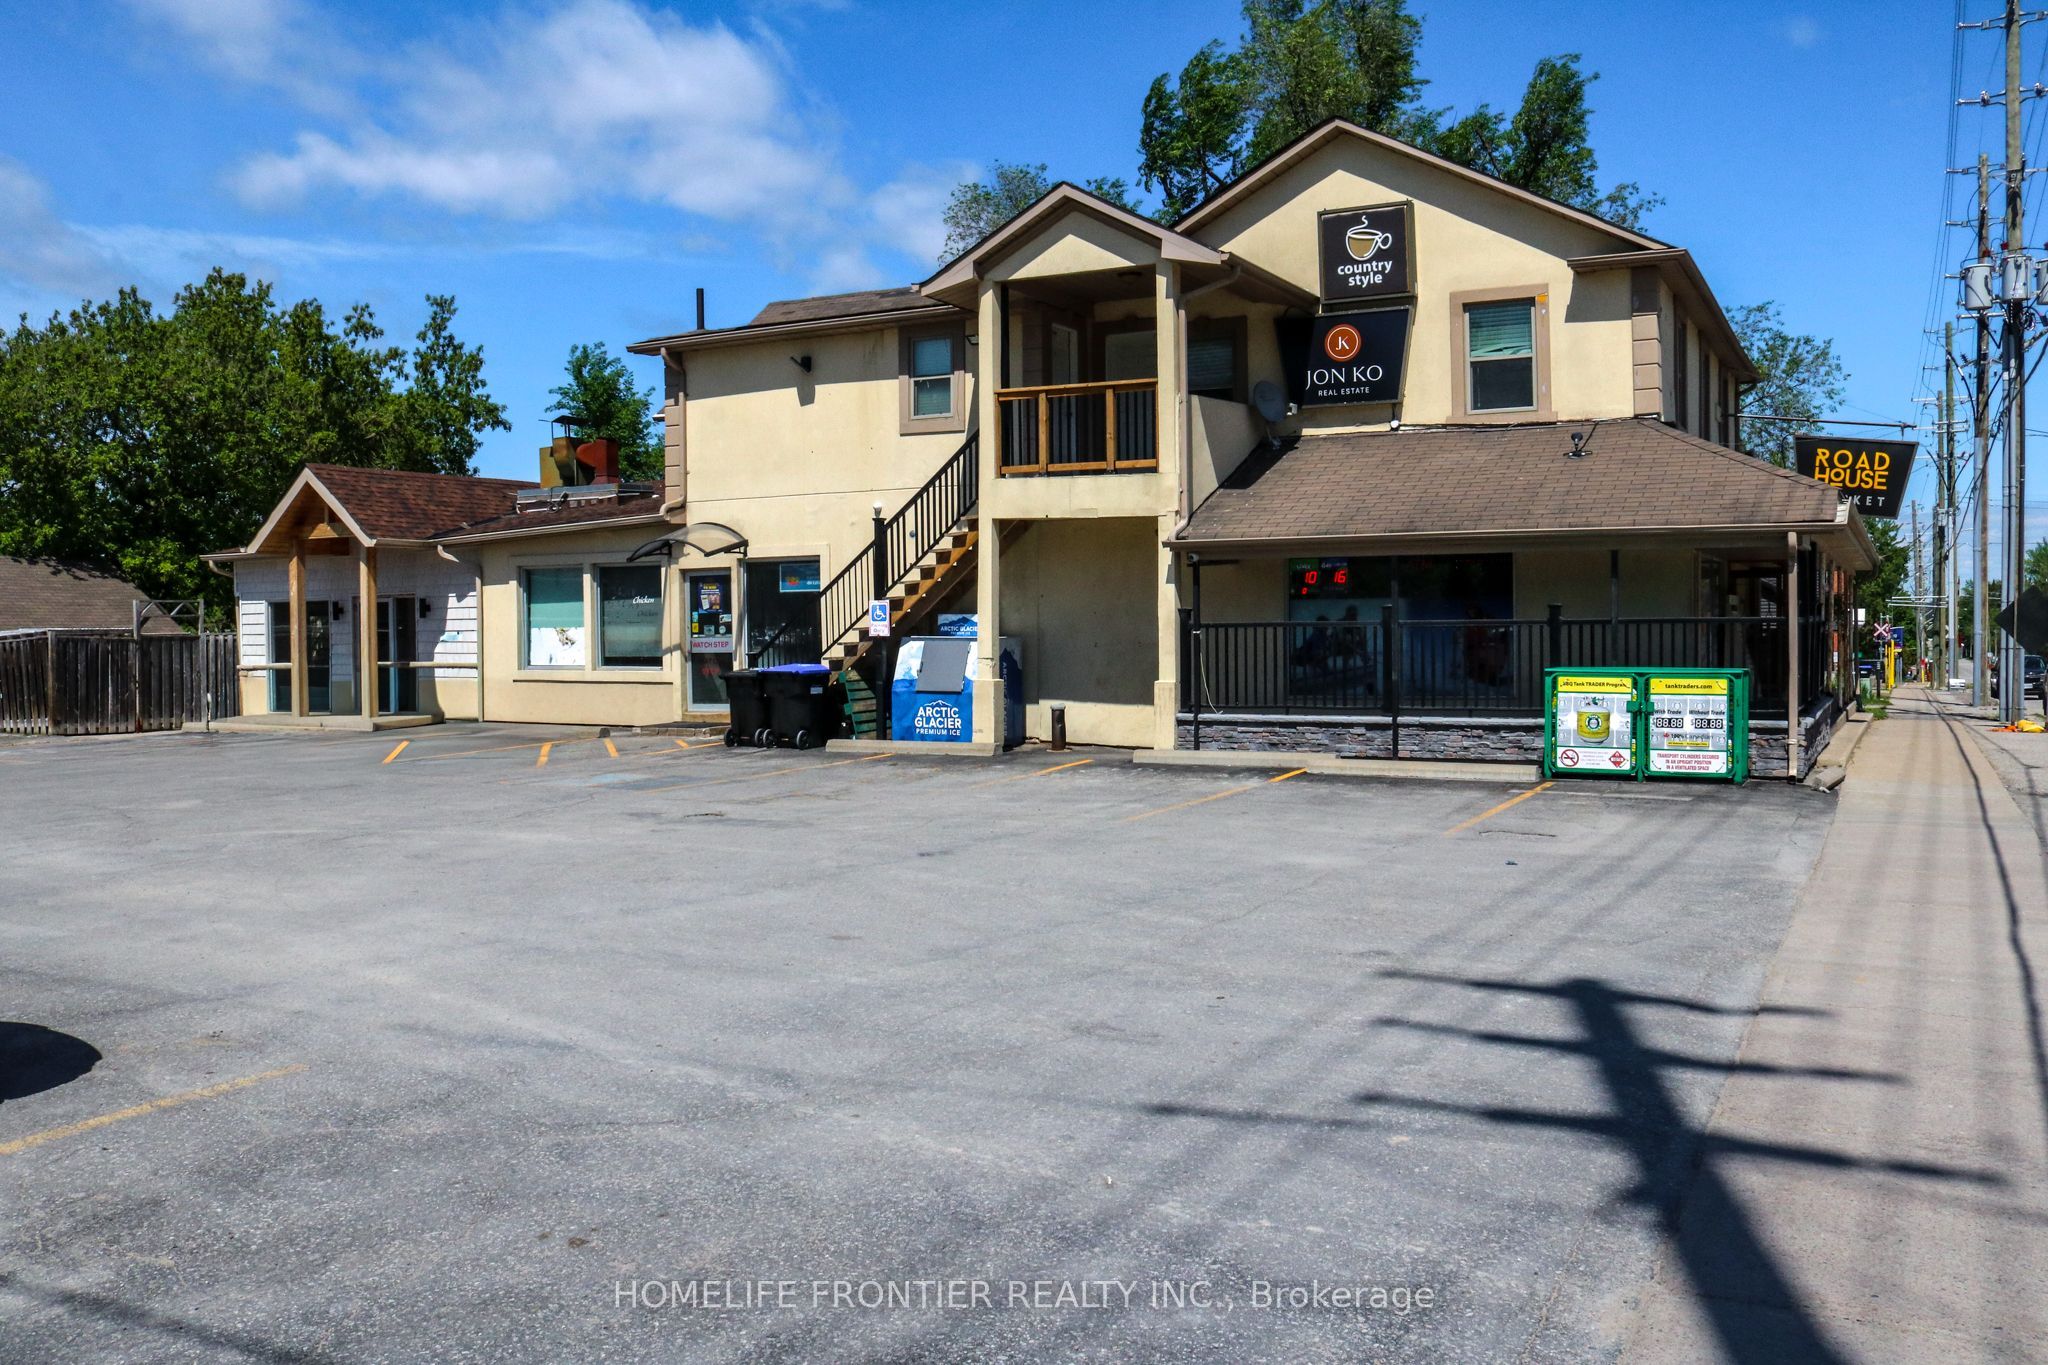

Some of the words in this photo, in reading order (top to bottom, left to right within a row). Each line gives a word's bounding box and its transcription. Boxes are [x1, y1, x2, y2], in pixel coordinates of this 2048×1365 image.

[1338, 260, 1392, 275] country
[1348, 271, 1382, 288] style
[1306, 367, 1345, 390] JON
[1353, 365, 1383, 382] KO
[1341, 387, 1370, 395] ESTATE
[1816, 448, 1890, 470] ROAD
[1814, 467, 1888, 490] HOUSE
[1853, 495, 1885, 507] KET
[1305, 571, 1318, 584] 10
[1334, 570, 1346, 584] 16
[632, 595, 655, 604] Chicken
[917, 707, 959, 718] ARCTIC
[914, 717, 961, 728] GLACIER
